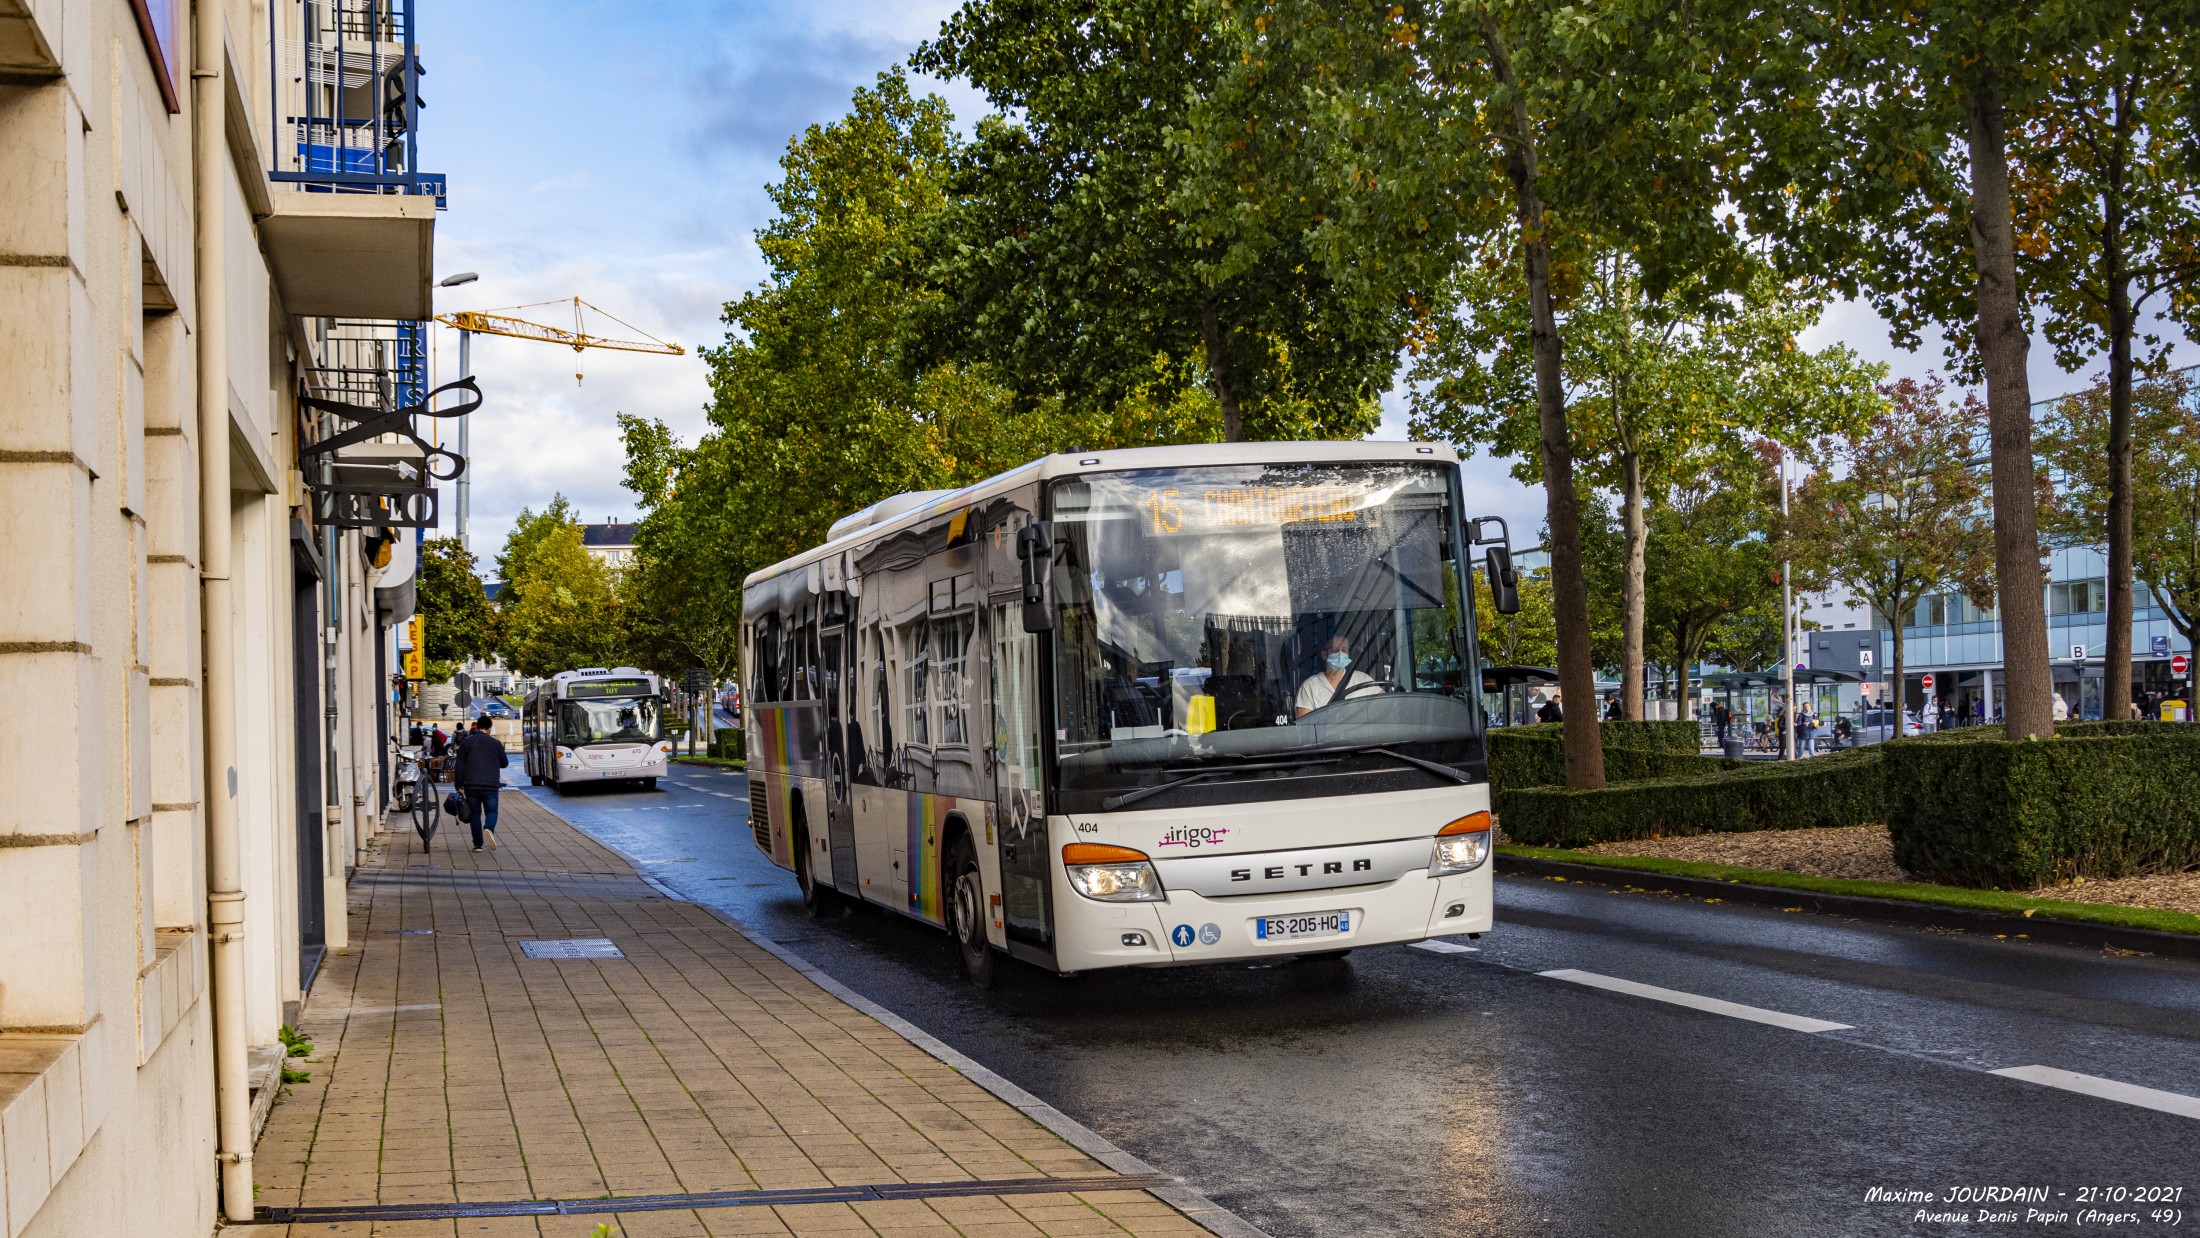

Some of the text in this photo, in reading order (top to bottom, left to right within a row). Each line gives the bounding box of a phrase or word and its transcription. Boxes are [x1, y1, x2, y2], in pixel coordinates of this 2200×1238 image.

[1146, 489, 1183, 534] 15
[1862, 652, 1871, 664] A
[2074, 646, 2083, 658] B
[1275, 714, 1288, 726] 404
[1078, 823, 1099, 834] 404
[1169, 825, 1212, 848] irigo
[1230, 858, 1372, 882] SETRA
[1266, 915, 1339, 936] ES-205-HQ
